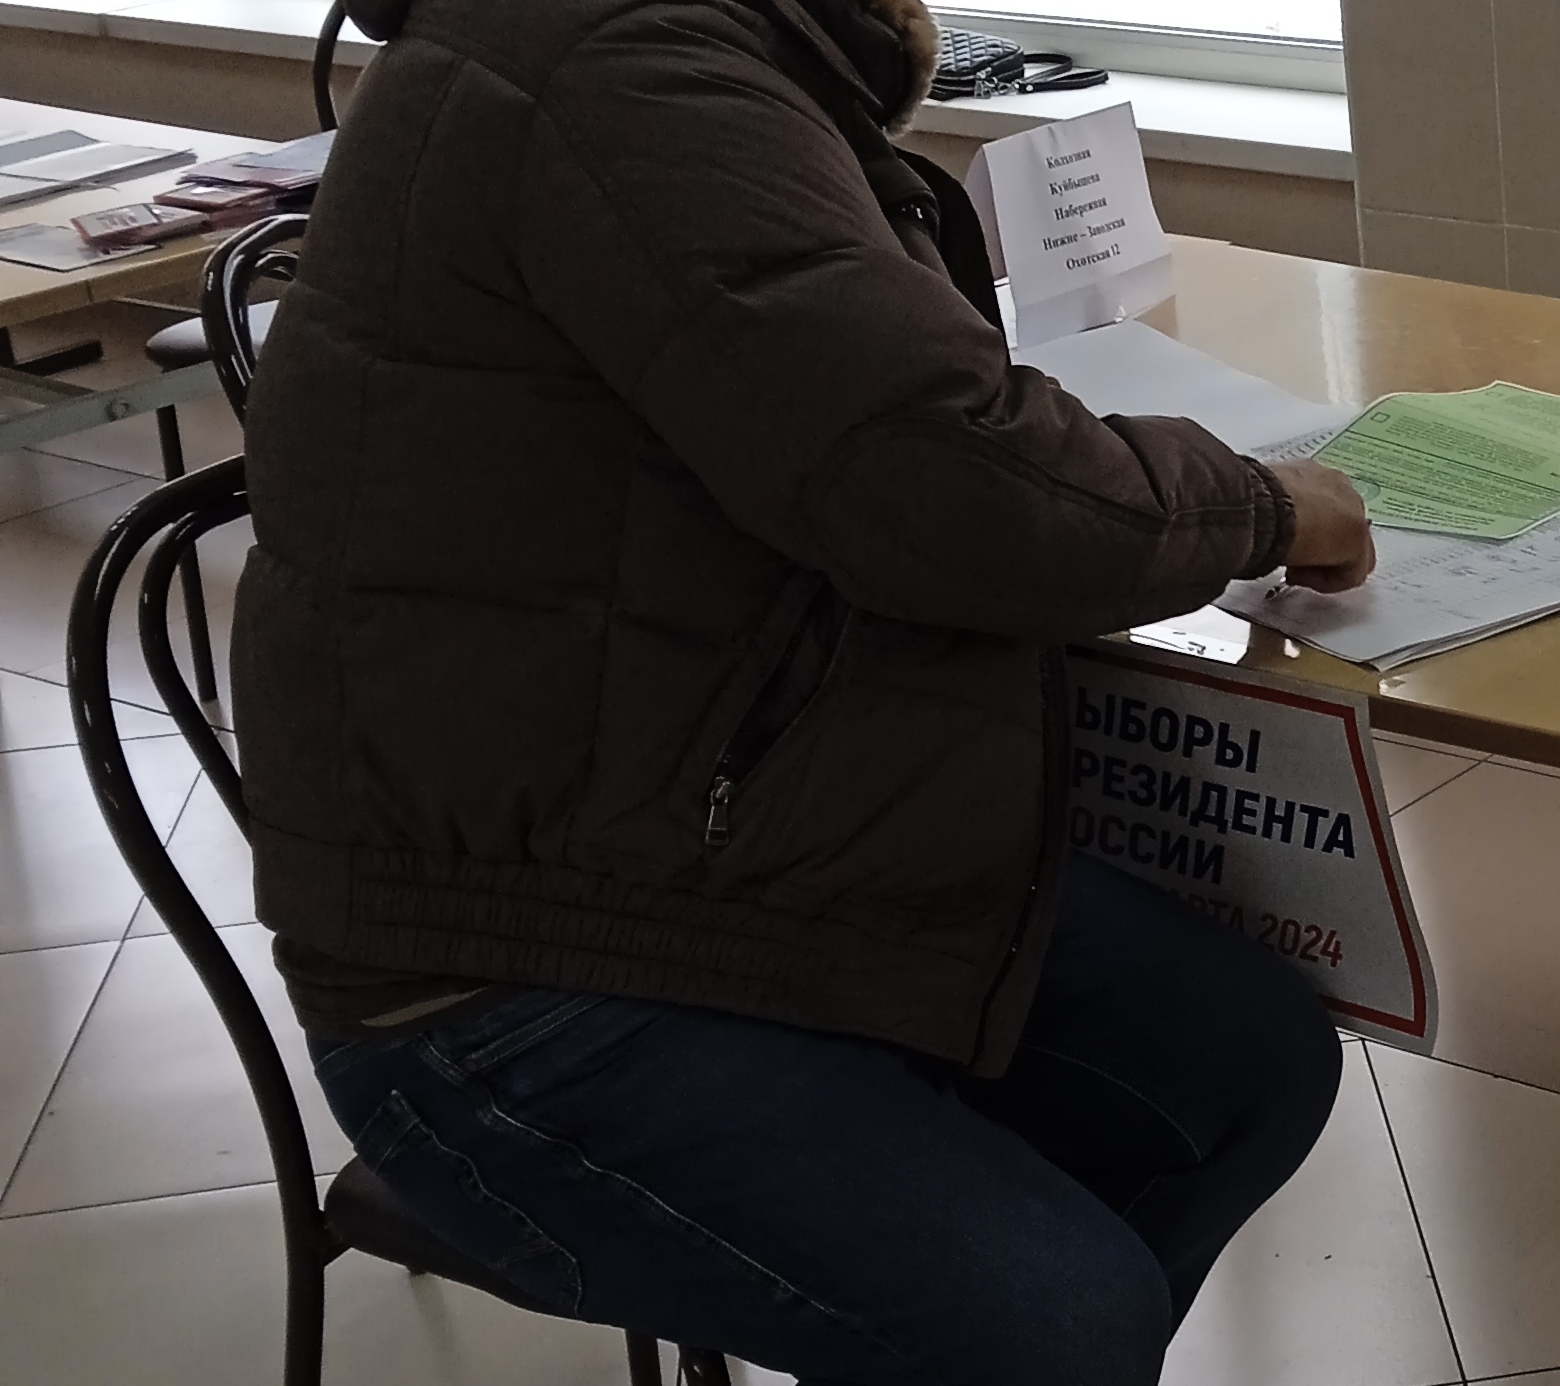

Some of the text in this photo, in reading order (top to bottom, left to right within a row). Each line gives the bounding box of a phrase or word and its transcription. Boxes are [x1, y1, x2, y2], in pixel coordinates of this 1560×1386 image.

[1111, 243, 1121, 256] 12
[1074, 685, 1261, 774] ЫБОРЫ
[1072, 747, 1356, 860] РЕЗИДЕНТА
[1070, 804, 1225, 885] ОССИИ
[1256, 913, 1343, 968] 2024
